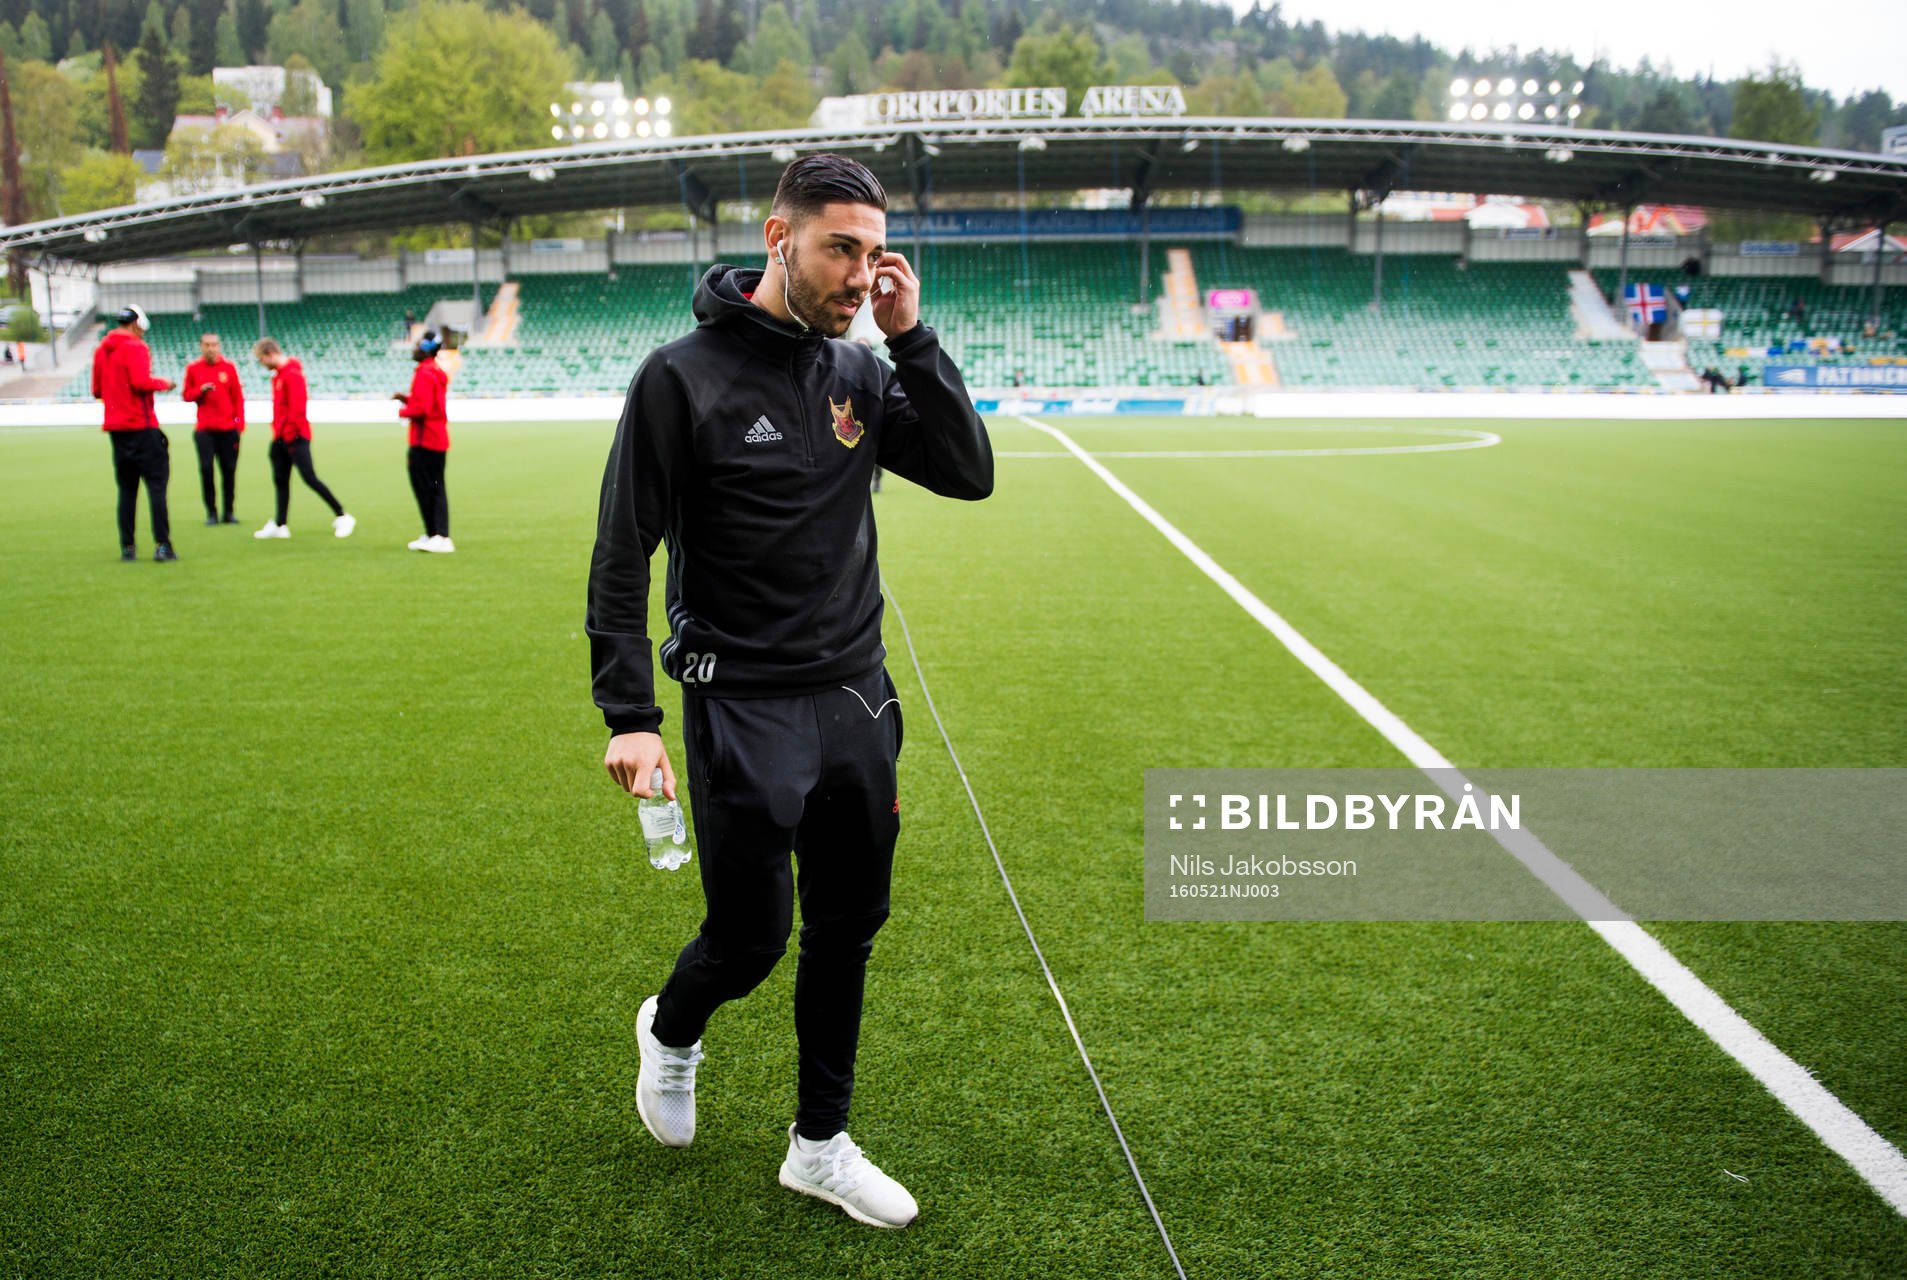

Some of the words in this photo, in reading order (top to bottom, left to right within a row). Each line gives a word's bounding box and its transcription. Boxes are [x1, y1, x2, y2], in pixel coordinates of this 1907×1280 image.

[849, 87, 1067, 122] ORRPORTEN
[1079, 86, 1188, 116] ARENA
[744, 431, 783, 444] adidas
[682, 652, 717, 683] 20
